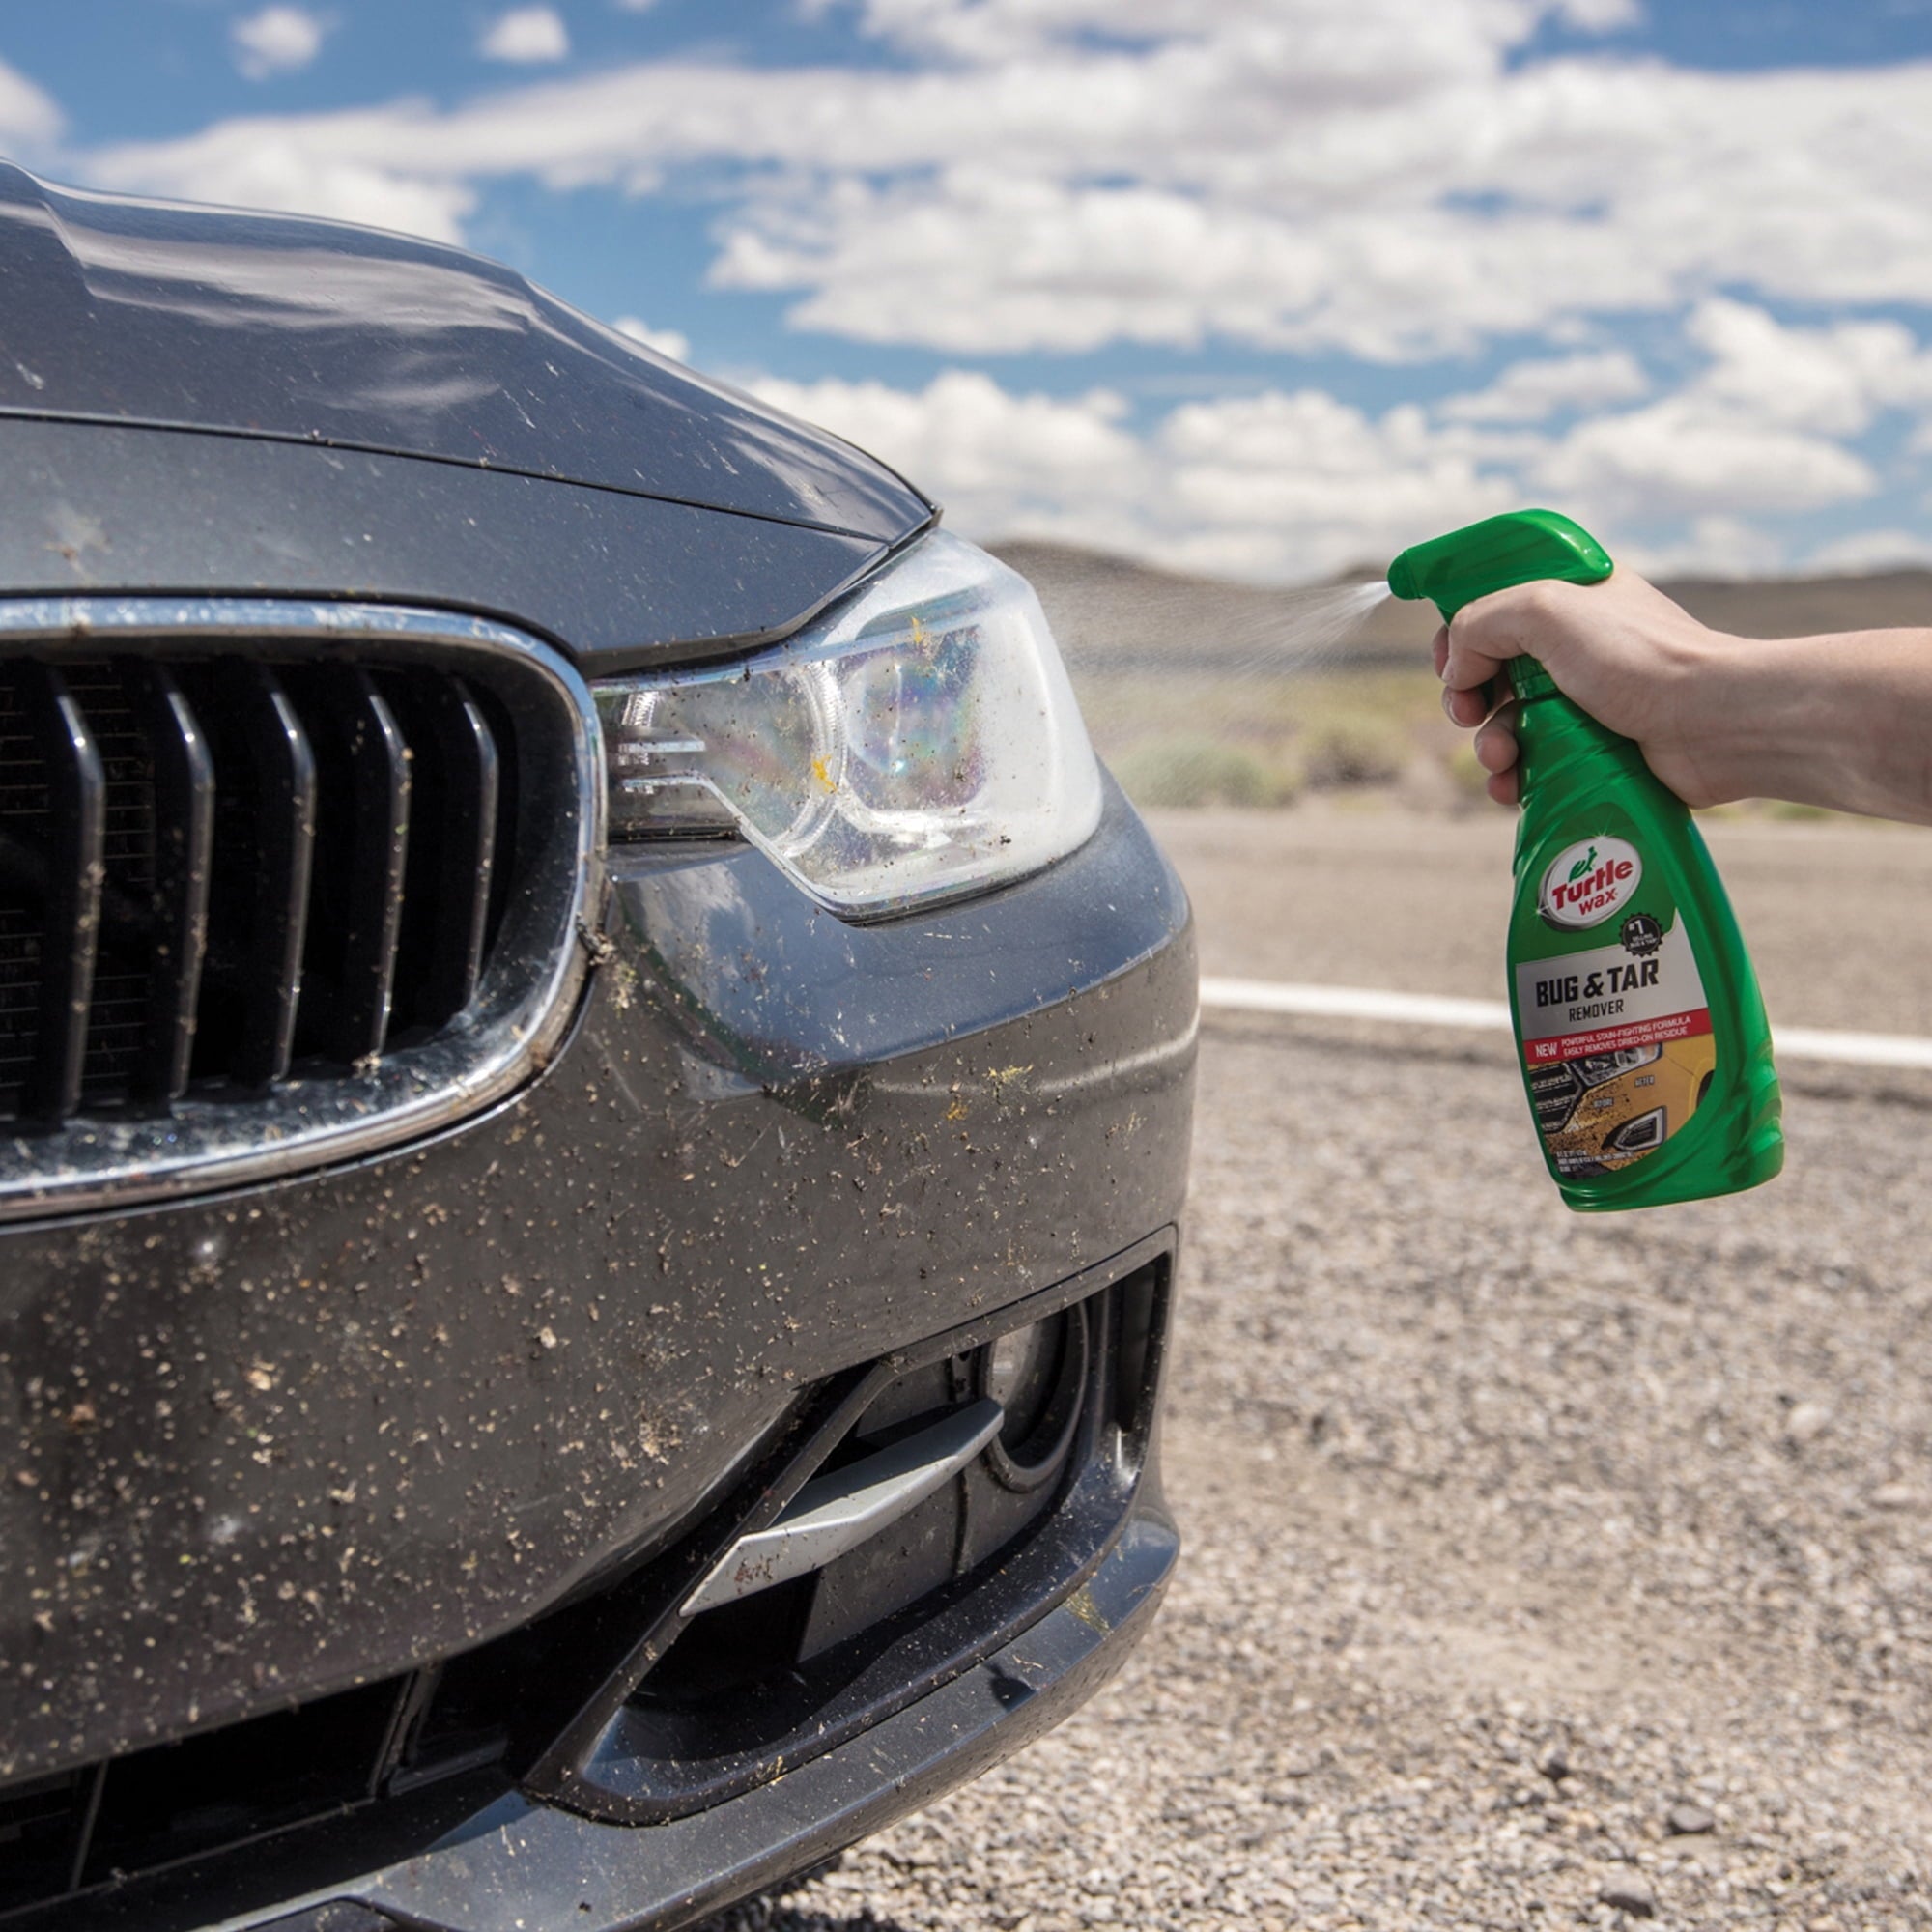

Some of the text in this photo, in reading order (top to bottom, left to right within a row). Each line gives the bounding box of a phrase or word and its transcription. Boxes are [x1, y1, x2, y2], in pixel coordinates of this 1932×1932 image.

[1552, 859, 1634, 910] Turtle
[1579, 888, 1617, 916] wax
[1536, 959, 1659, 1007] BUG & TAR
[1569, 999, 1624, 1023] REMOVER
[1561, 1035, 1595, 1047] POWERFUL
[1653, 1015, 1691, 1030] FORMULA
[1563, 1046, 1583, 1057] EASILY
[1584, 1040, 1617, 1053] REMOVES
[1654, 1026, 1688, 1039] RESIDUE
[1534, 1042, 1558, 1057] NEW
